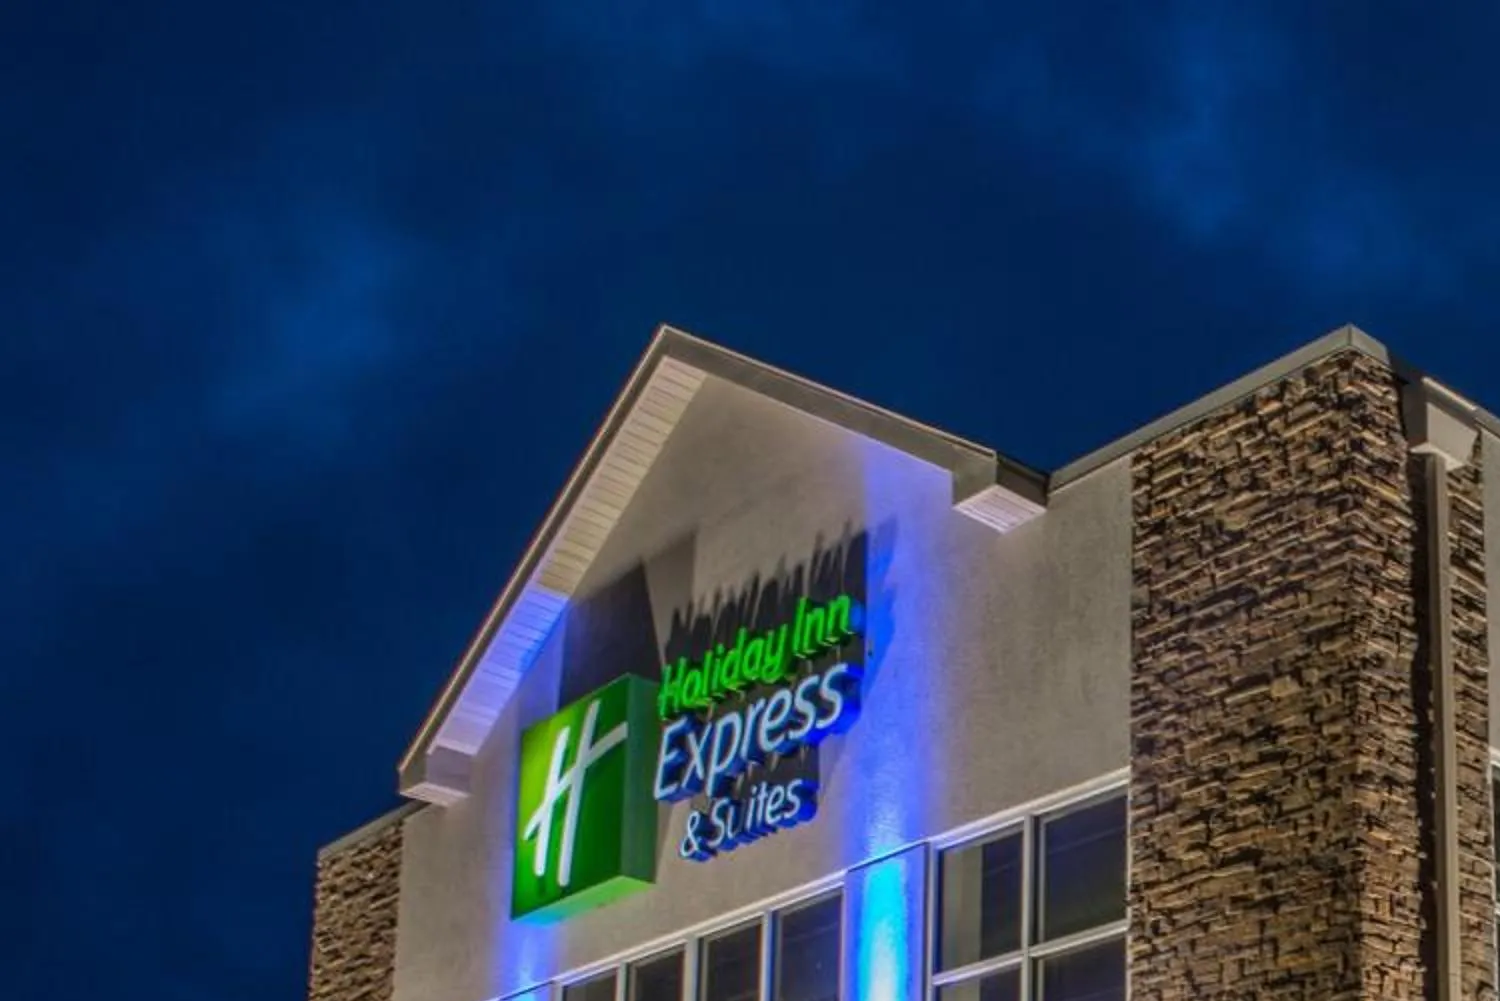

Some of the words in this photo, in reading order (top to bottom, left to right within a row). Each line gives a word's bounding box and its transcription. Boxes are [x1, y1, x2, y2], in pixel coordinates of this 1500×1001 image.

[658, 622, 789, 722] Holiday
[792, 594, 852, 656] Inn
[653, 662, 849, 801] Express
[680, 810, 701, 858] &
[706, 778, 803, 848] Suites
